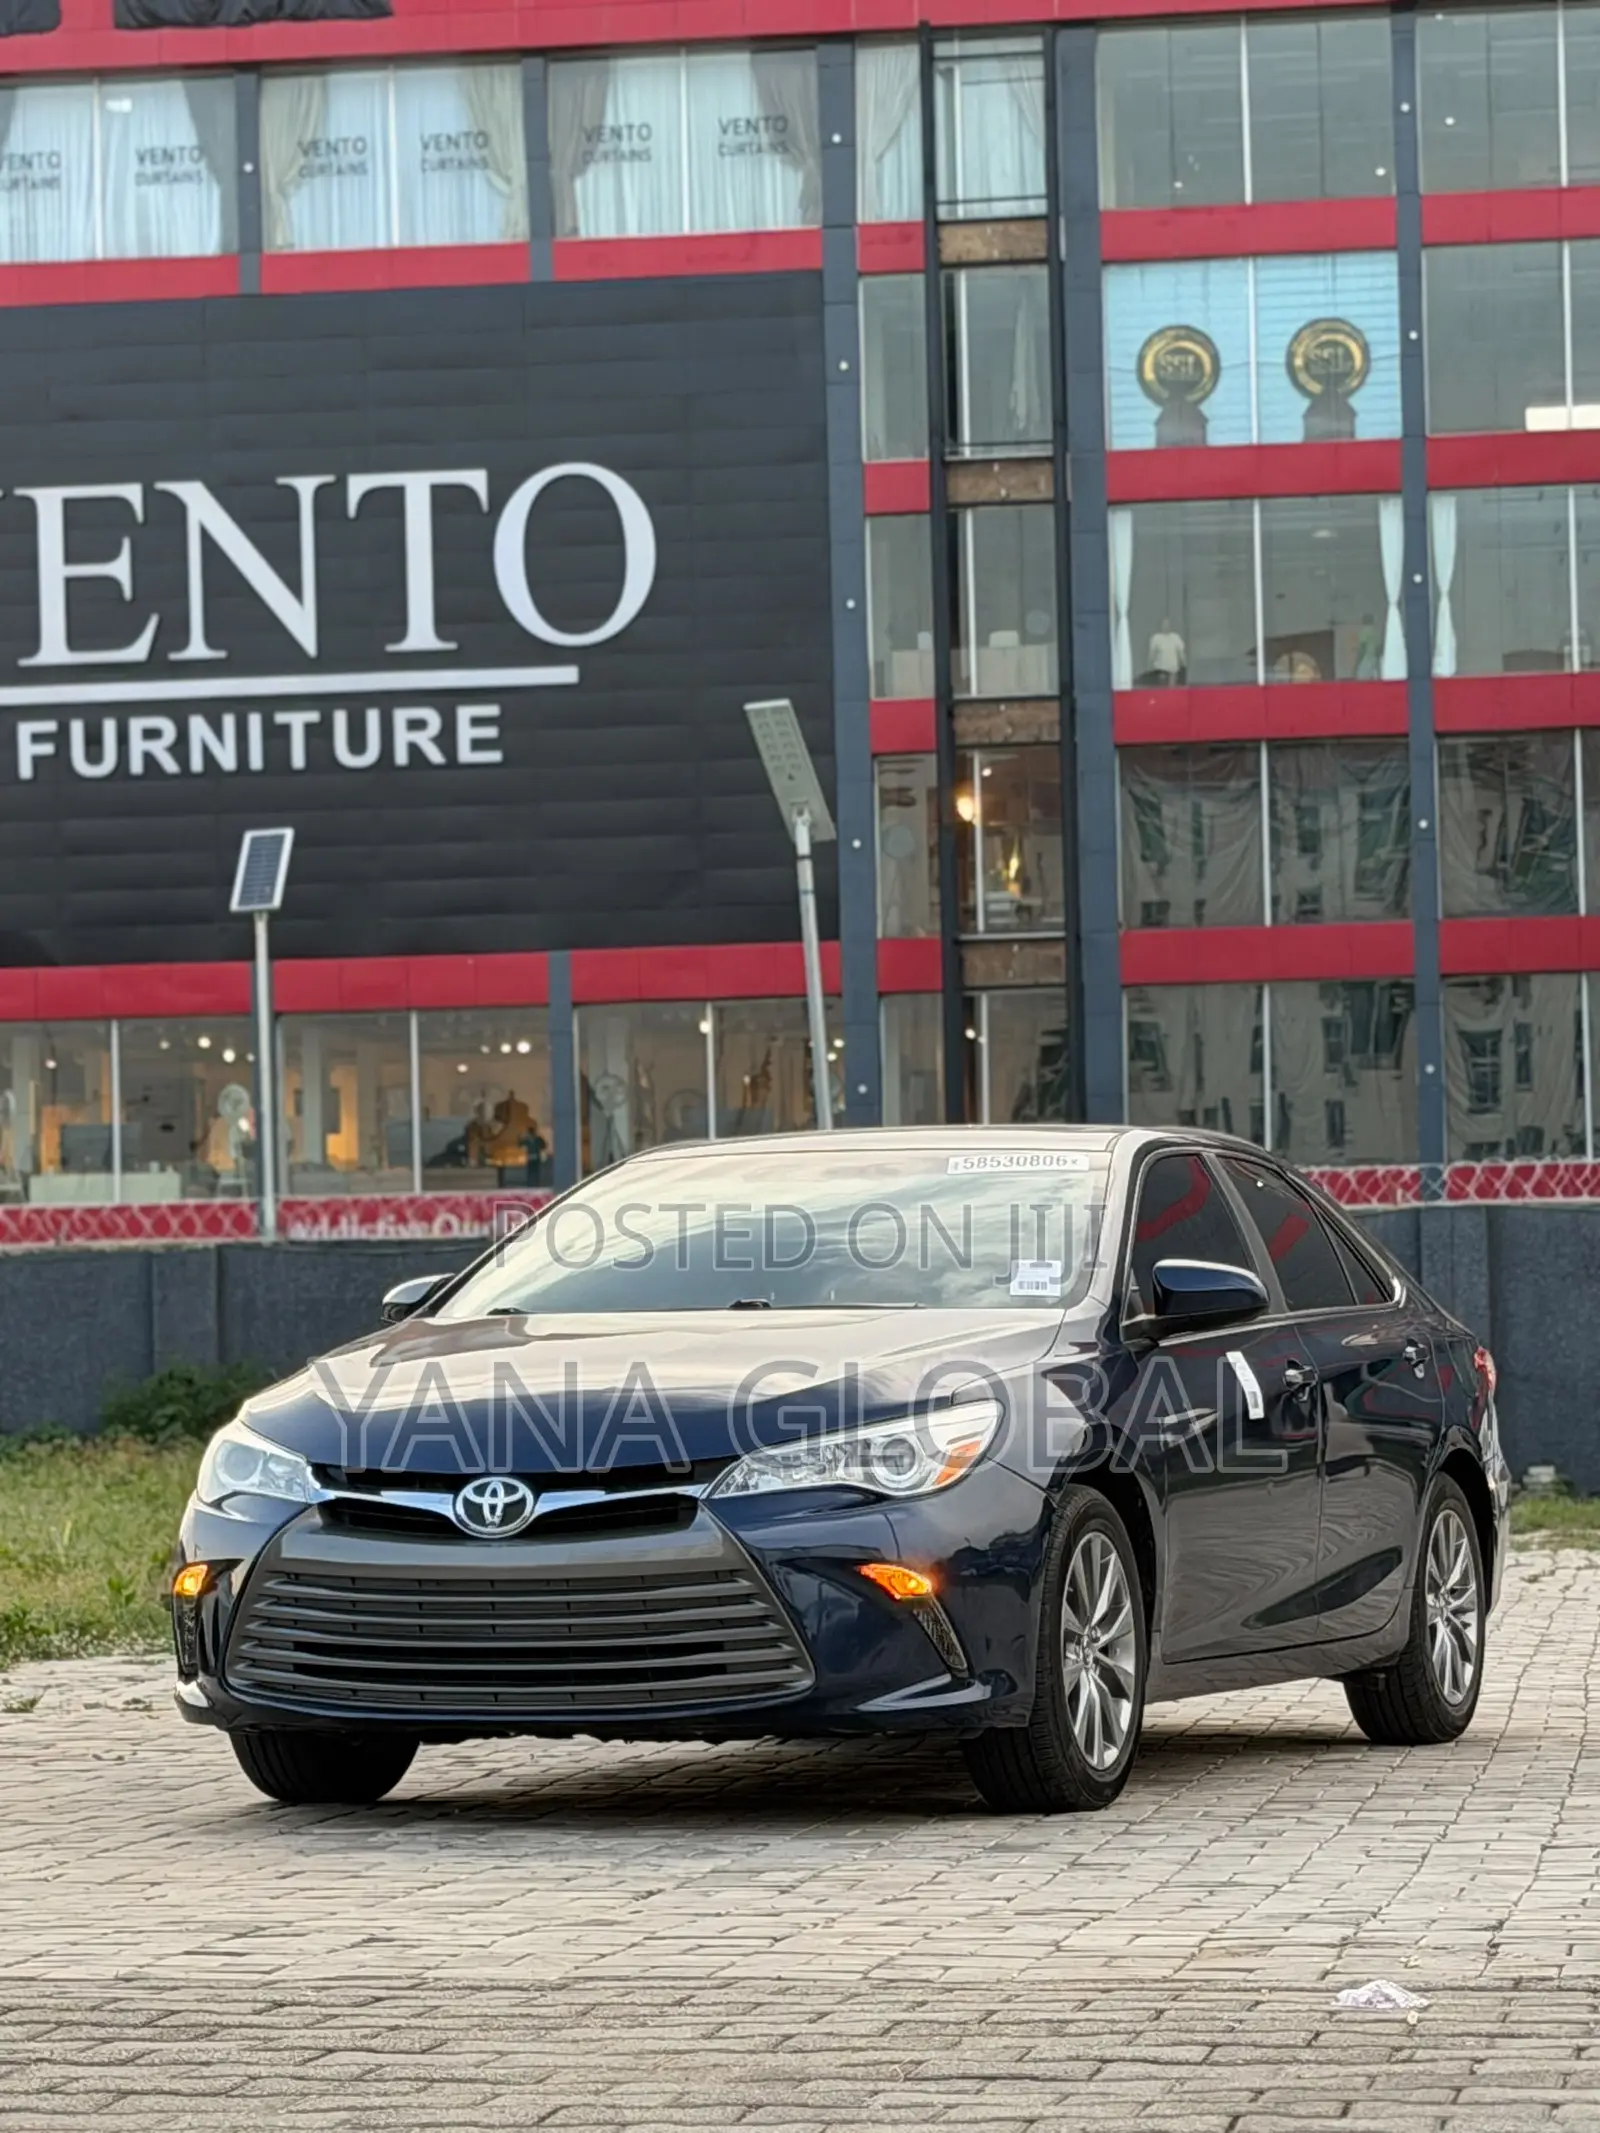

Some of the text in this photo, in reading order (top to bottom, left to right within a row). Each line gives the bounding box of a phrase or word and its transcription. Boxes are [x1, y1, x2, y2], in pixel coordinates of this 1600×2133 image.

[581, 123, 653, 144] VENTO
[717, 114, 787, 137] VENTO
[298, 135, 368, 158] VENTO
[421, 129, 489, 151] VENTO
[135, 145, 203, 167] VENTO
[0, 462, 656, 666] ENTO
[15, 703, 504, 780] FURNITURE
